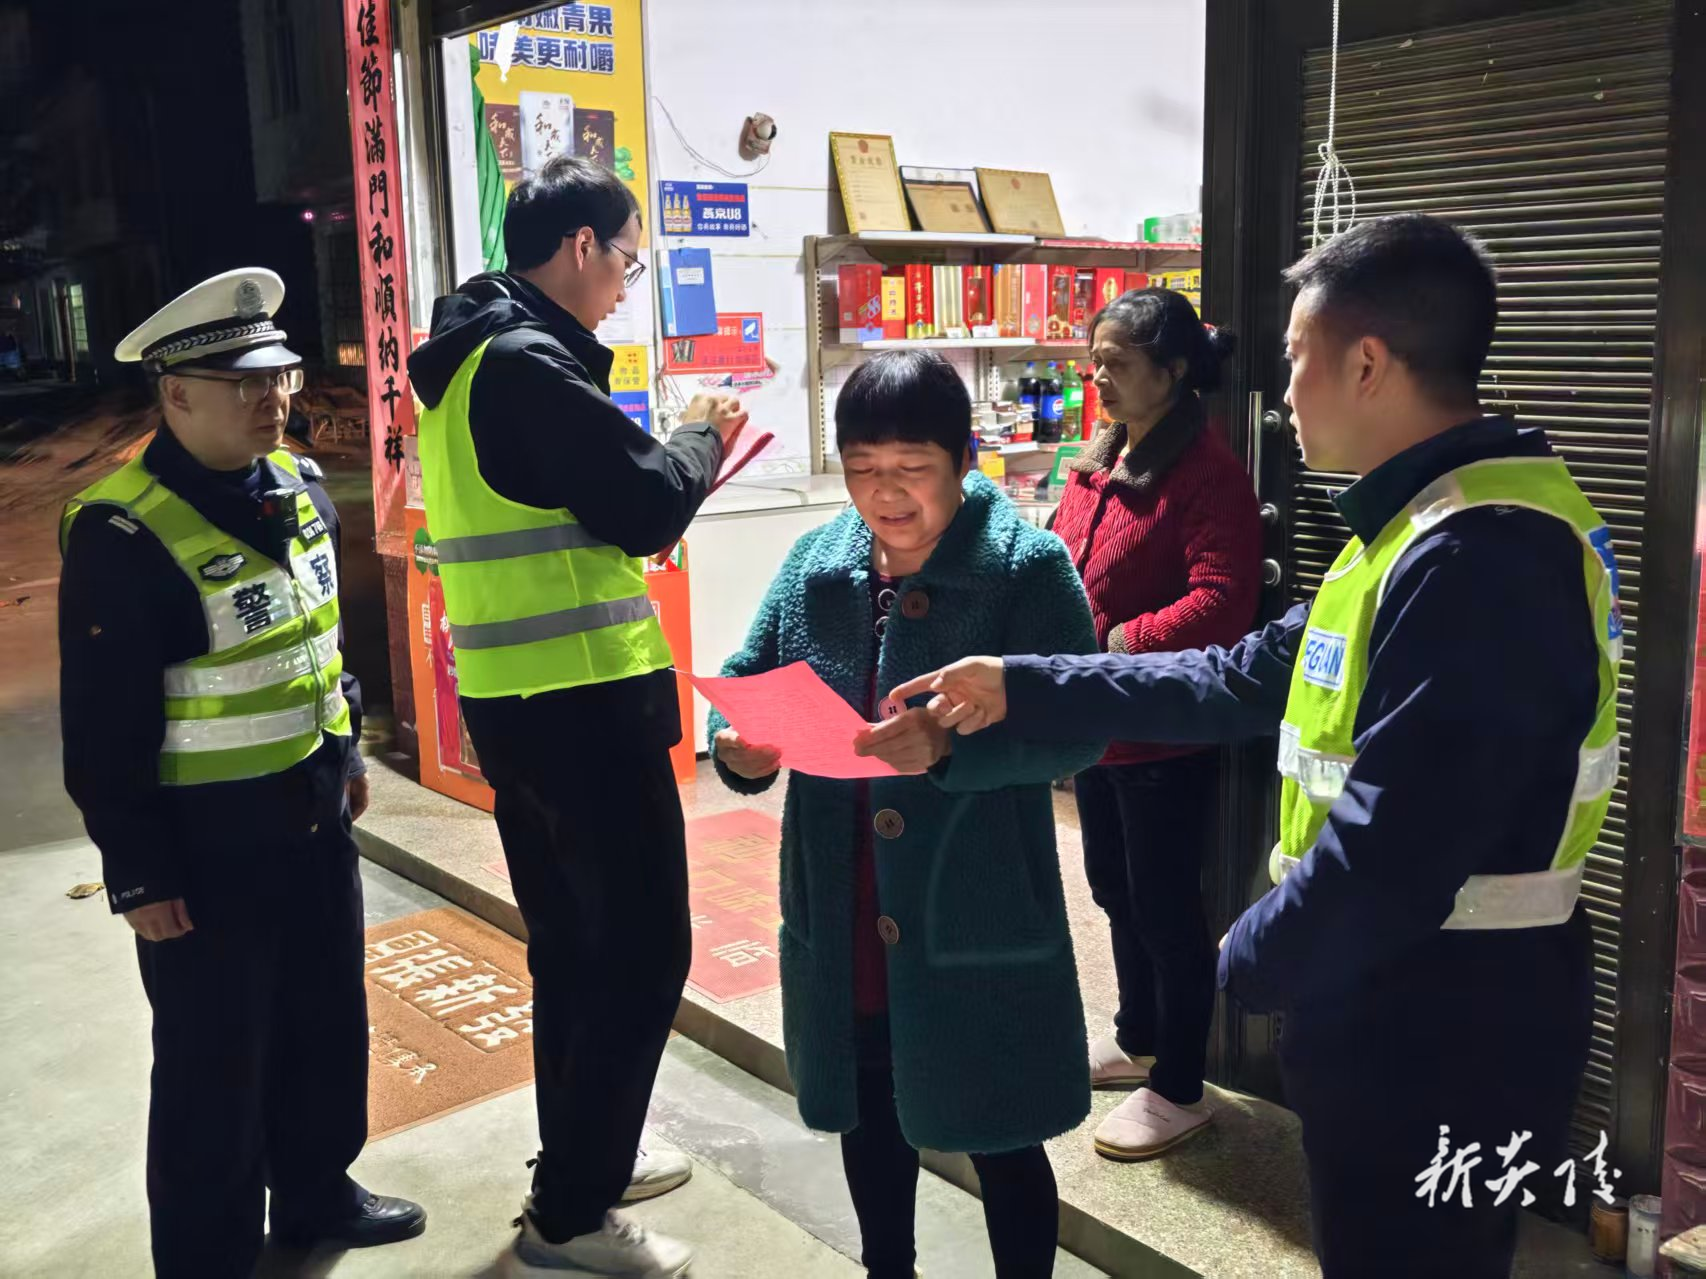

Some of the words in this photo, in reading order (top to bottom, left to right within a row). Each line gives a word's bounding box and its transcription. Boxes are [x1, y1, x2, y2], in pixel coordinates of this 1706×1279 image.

[517, 3, 613, 36] 嫩青果
[232, 582, 271, 634] 警
[310, 553, 335, 597] 察
